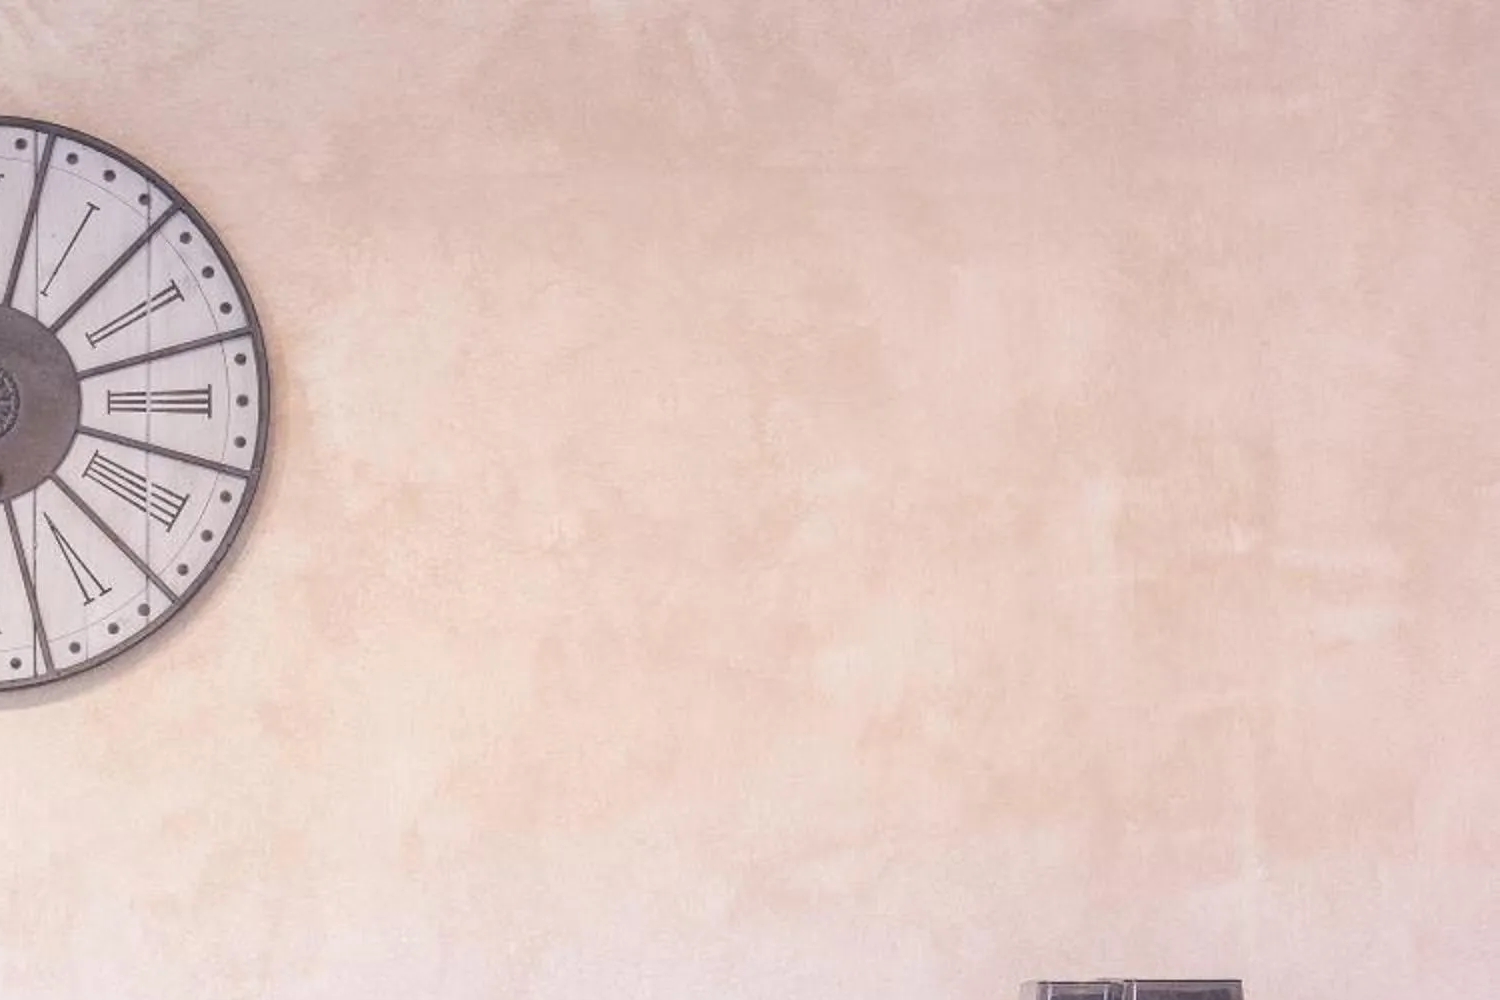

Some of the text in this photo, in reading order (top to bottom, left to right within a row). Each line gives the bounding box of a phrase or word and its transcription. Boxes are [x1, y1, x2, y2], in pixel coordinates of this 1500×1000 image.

[40, 202, 100, 296] I
[85, 279, 185, 348] II
[107, 384, 212, 418] III
[82, 450, 191, 532] IIII
[43, 512, 112, 606] V
